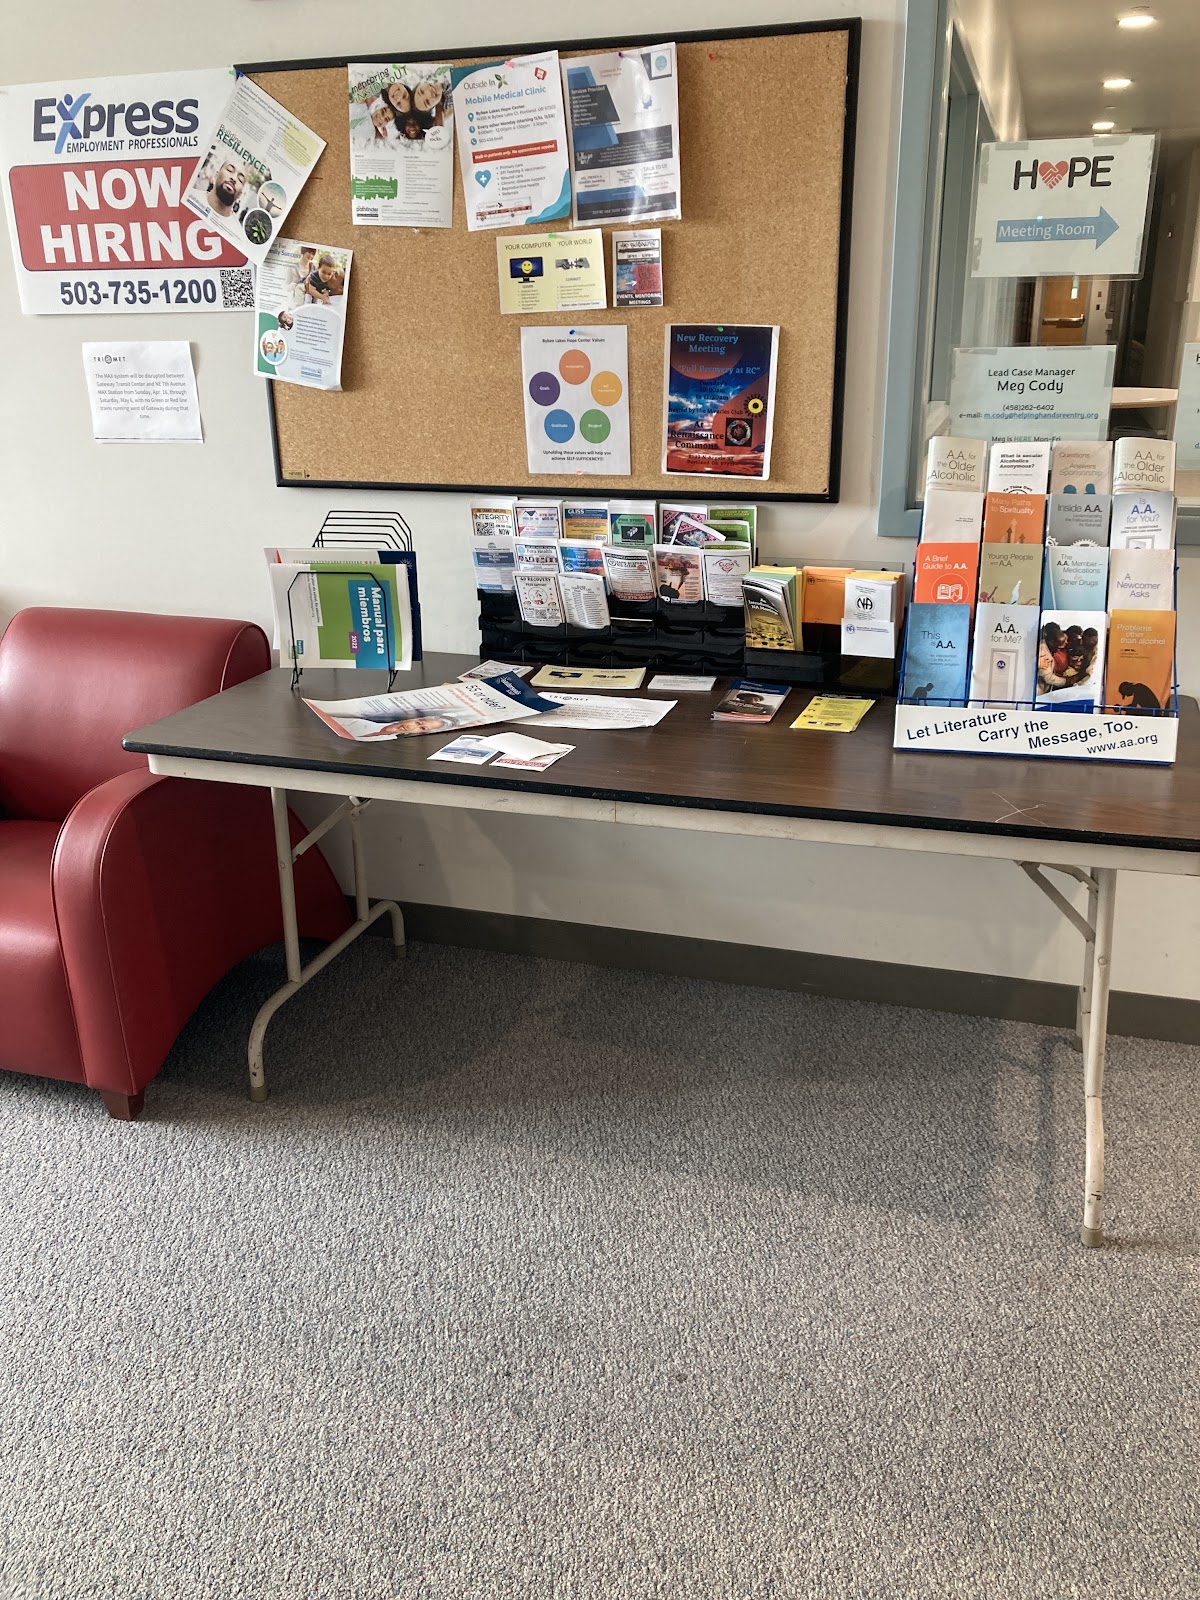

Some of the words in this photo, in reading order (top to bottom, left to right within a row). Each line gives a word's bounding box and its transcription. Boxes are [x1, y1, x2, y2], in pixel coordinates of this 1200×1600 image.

[351, 67, 390, 95] mentoring
[463, 81, 488, 90] Outside
[465, 95, 492, 105] Mobile
[493, 89, 524, 101] Medical
[525, 85, 547, 96] Clinic
[219, 123, 242, 147] Building
[66, 139, 124, 154] EMPLOYMENT
[128, 136, 198, 150] PROFESSIONALS
[63, 166, 183, 211] NOW
[998, 225, 1052, 240] Meeting
[1056, 223, 1095, 236] Room
[40, 220, 223, 264] HIRING
[505, 243, 521, 251] YOUR
[521, 241, 552, 250] COMPUTER
[557, 239, 573, 247] YOUR
[574, 238, 593, 246] WORLD
[60, 279, 217, 305] 503-735-1200
[676, 333, 696, 342] New
[698, 333, 739, 345] Recovery
[688, 344, 726, 355] Meeting
[698, 365, 734, 375] Recovery
[988, 368, 1009, 377] Lead
[1011, 368, 1033, 377] Case
[1035, 368, 1075, 378] Manager
[997, 381, 1025, 395] Meg
[1029, 380, 1064, 394] Cody
[1002, 404, 1055, 412] (458)262-6402
[983, 411, 1099, 420] m.cody@helpinghandsreentry.org
[670, 430, 725, 440] Renaissance
[675, 441, 718, 450] Commons
[946, 449, 967, 461] A.A.
[1134, 450, 1155, 461] A.A.
[948, 460, 976, 472] Older
[1136, 460, 1165, 473] Older
[930, 469, 976, 483] Alcoholic
[1059, 469, 1103, 478] Sponsorship
[1117, 471, 1165, 484] Alcoholic
[991, 497, 1010, 506] Many
[1011, 498, 1032, 506] Paths
[1139, 497, 1146, 505] Is
[999, 506, 1035, 515] Spirituality
[1057, 503, 1082, 512] Inside
[1084, 504, 1103, 513] A.A.
[1130, 504, 1156, 514] A.A.
[1127, 516, 1137, 524] for
[1139, 514, 1160, 523] You?
[498, 528, 510, 536] NOW
[987, 552, 1009, 561] Young
[1010, 553, 1034, 562] People
[922, 562, 943, 570] Guide
[953, 562, 969, 570] A.A.
[1078, 579, 1099, 587] Drugs
[1116, 581, 1161, 590] Newcomer
[1129, 590, 1150, 598] Asks
[370, 586, 386, 628] Manual
[856, 597, 873, 611] NA
[357, 586, 372, 643] miembros
[1002, 614, 1010, 623] Is
[994, 622, 1019, 634] A.A.
[1117, 623, 1152, 632] Problems
[921, 630, 941, 639] This
[990, 634, 1003, 643] for
[1003, 634, 1022, 644] Me?
[372, 629, 385, 654] para
[936, 640, 956, 649] A.A.
[1120, 637, 1137, 645] than
[1138, 637, 1166, 645] alcohol
[465, 684, 480, 693] 55
[906, 726, 931, 740] Let
[934, 712, 1008, 734] Literature
[978, 726, 1019, 742] Carry
[1024, 720, 1049, 734] the
[1028, 727, 1103, 750] Message,
[1103, 720, 1139, 735] Too.
[1086, 733, 1158, 755] www.aa.org
